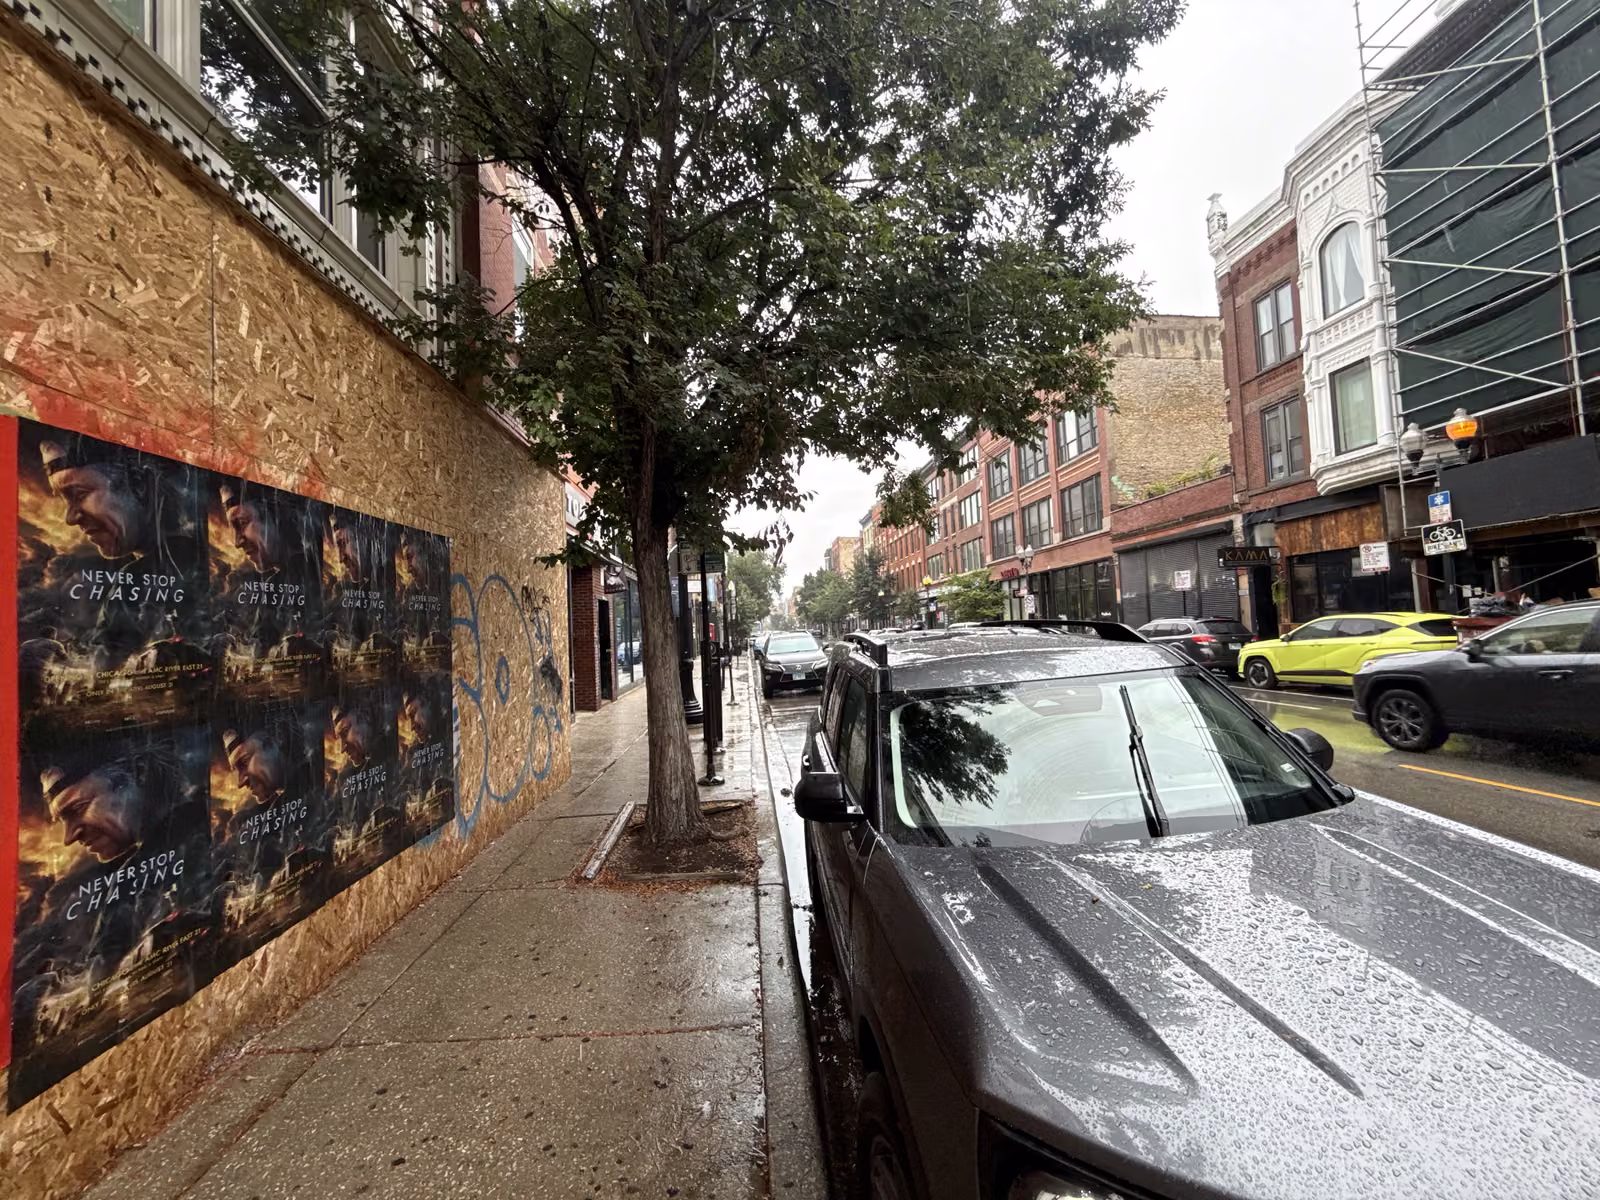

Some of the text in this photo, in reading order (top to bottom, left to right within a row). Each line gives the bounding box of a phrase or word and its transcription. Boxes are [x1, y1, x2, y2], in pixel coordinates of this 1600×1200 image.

[1225, 549, 1268, 561] KAMA
[82, 569, 176, 587] NEVER STOP
[70, 583, 185, 603] CHASING
[244, 581, 300, 594] NEVER STOP
[343, 590, 366, 599] NEVER
[237, 592, 305, 606] CHASING
[341, 598, 385, 610] CHASING
[408, 602, 441, 612] CHASING
[96, 669, 134, 680] CHICAGO
[164, 665, 181, 673] RIVER
[86, 688, 104, 697] ONLY
[145, 683, 168, 691] AUGUST
[411, 749, 444, 769] CHASING
[413, 746, 430, 759] NEVER
[346, 765, 383, 786] NEVER STOP
[342, 772, 387, 798] CHASING
[246, 798, 303, 829] NEVER STOP
[240, 806, 308, 845] CHASING
[78, 850, 176, 898] NEVER STOP
[66, 859, 184, 921] CHASING
[162, 941, 180, 955] RIVER
[179, 933, 195, 946] EAST
